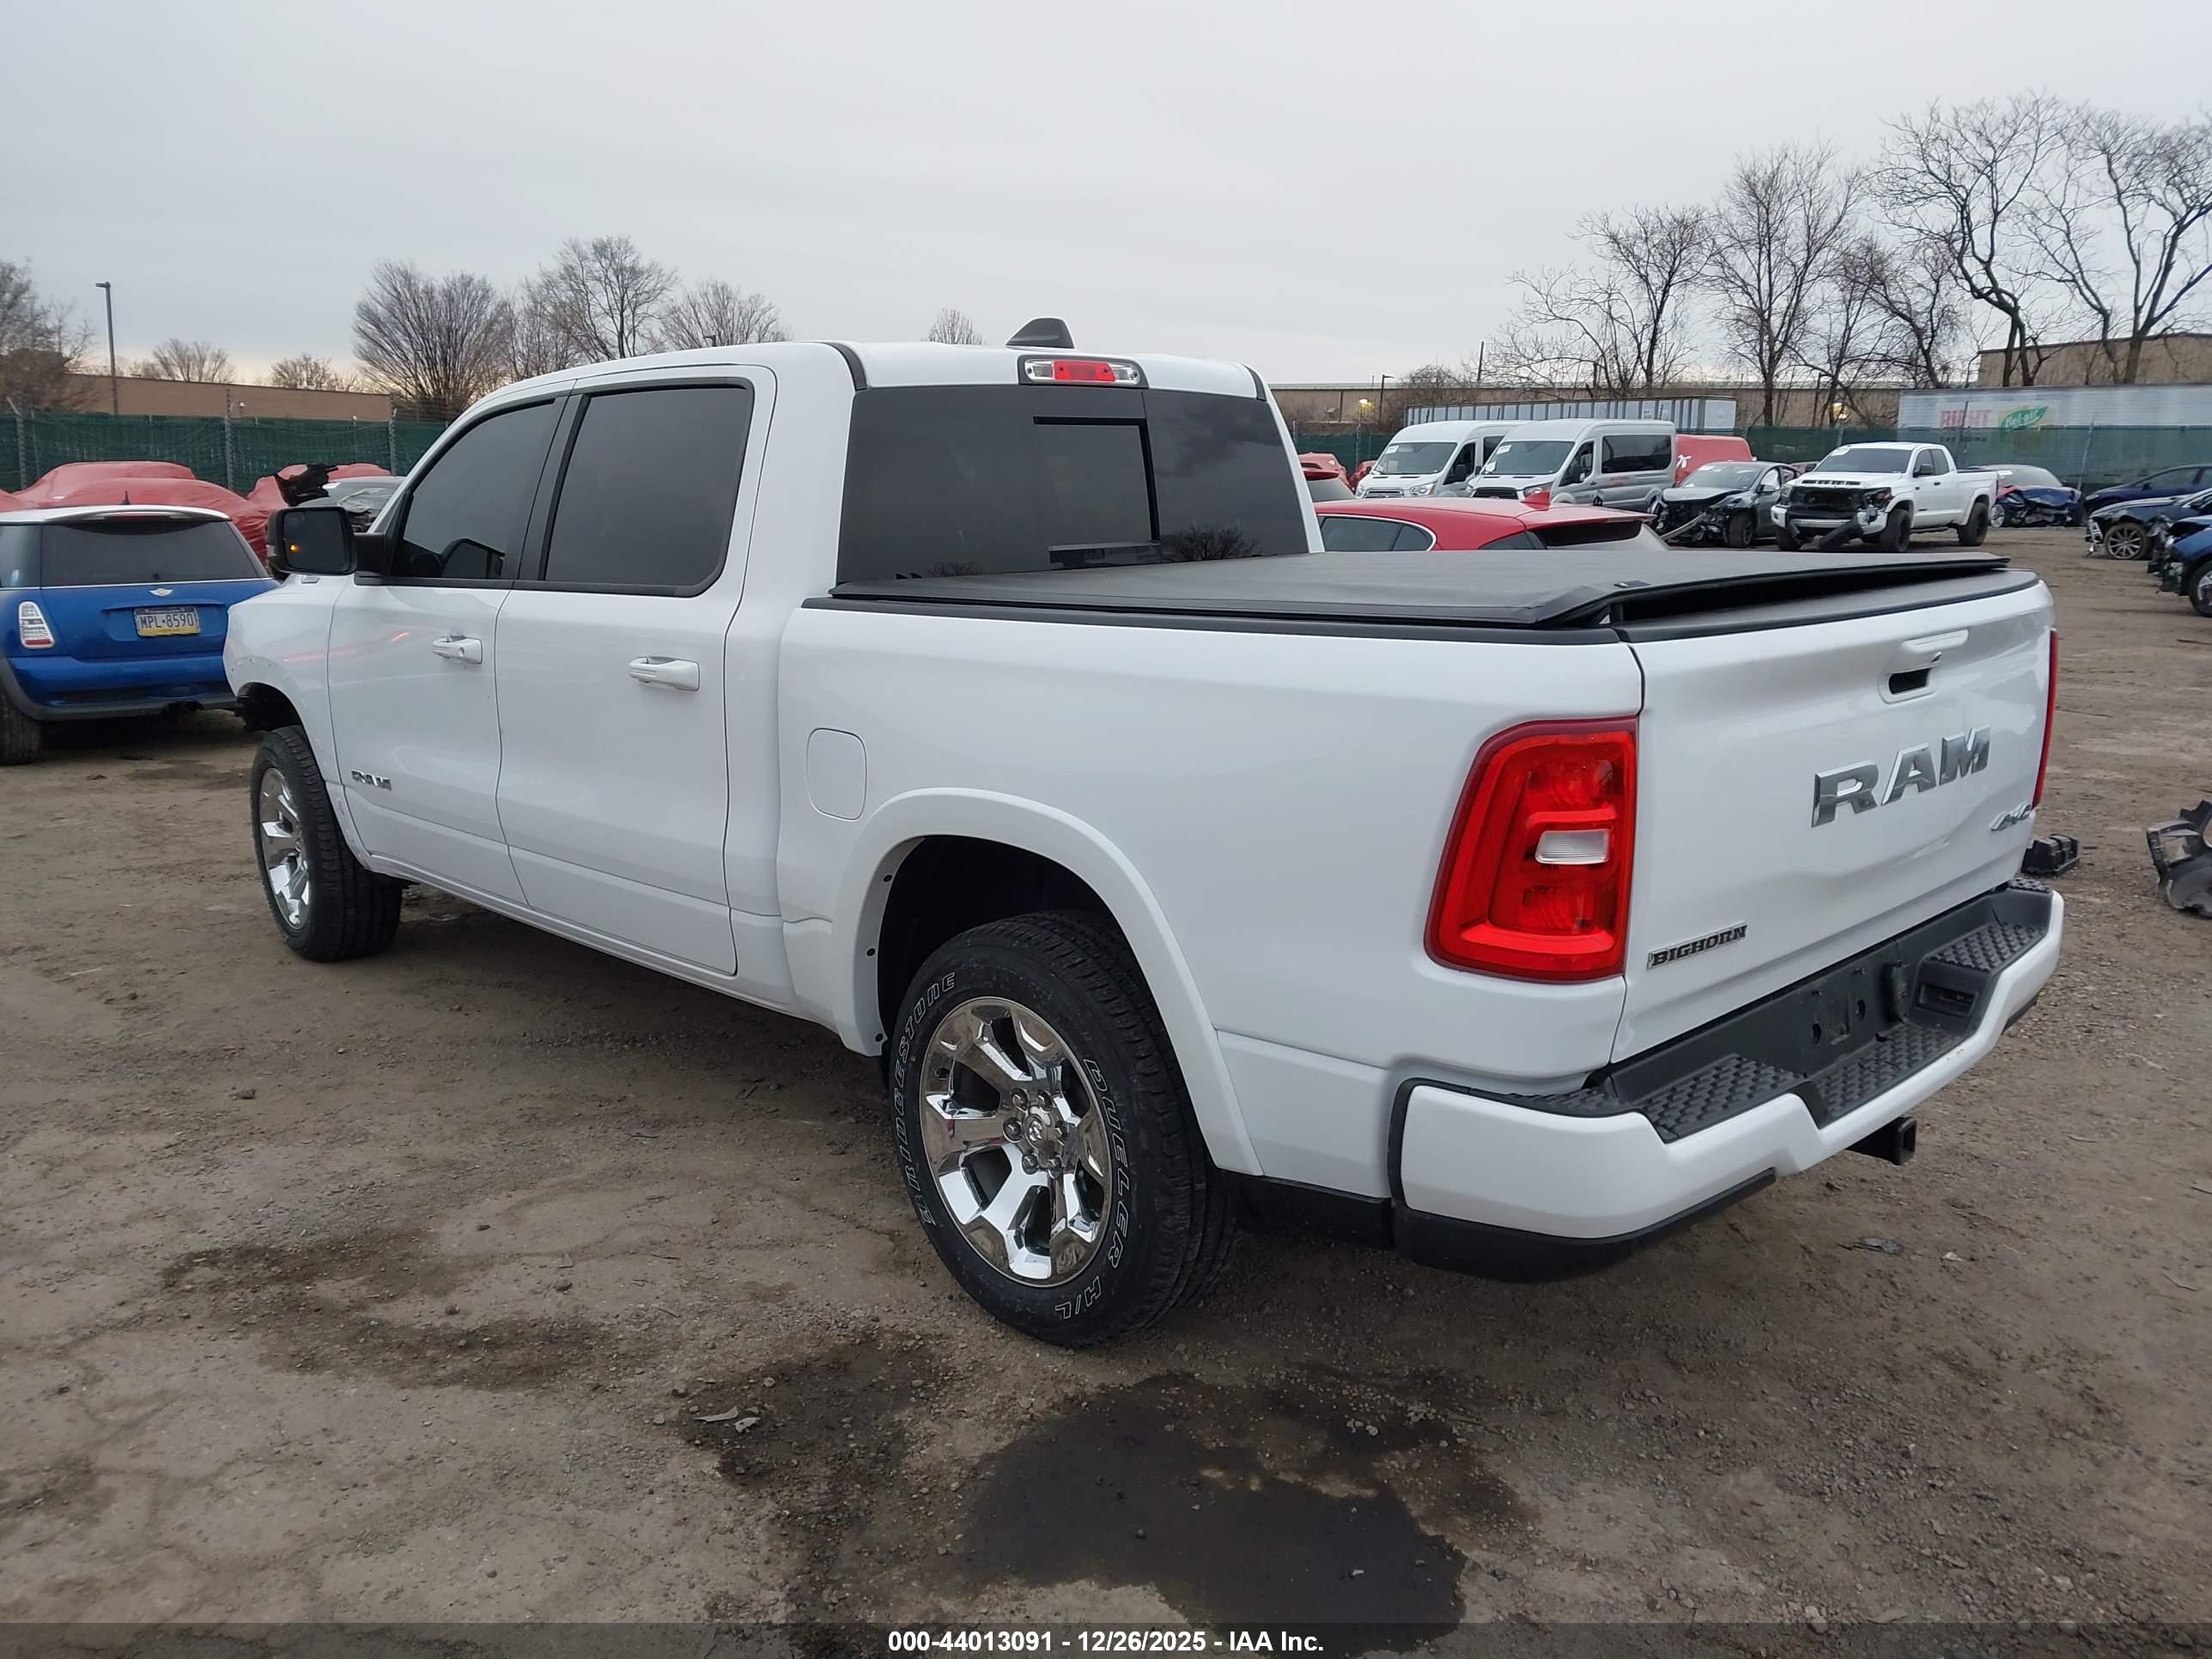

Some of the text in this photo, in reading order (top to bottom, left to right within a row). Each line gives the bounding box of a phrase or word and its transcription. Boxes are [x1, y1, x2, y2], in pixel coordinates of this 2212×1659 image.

[350, 769, 392, 790] RAM
[1812, 726, 1991, 828] RAM
[1650, 923, 1748, 969] BIGHORN
[894, 972, 956, 1226] BRIDGESTONE
[1054, 1059, 1130, 1320] DUELER H/L
